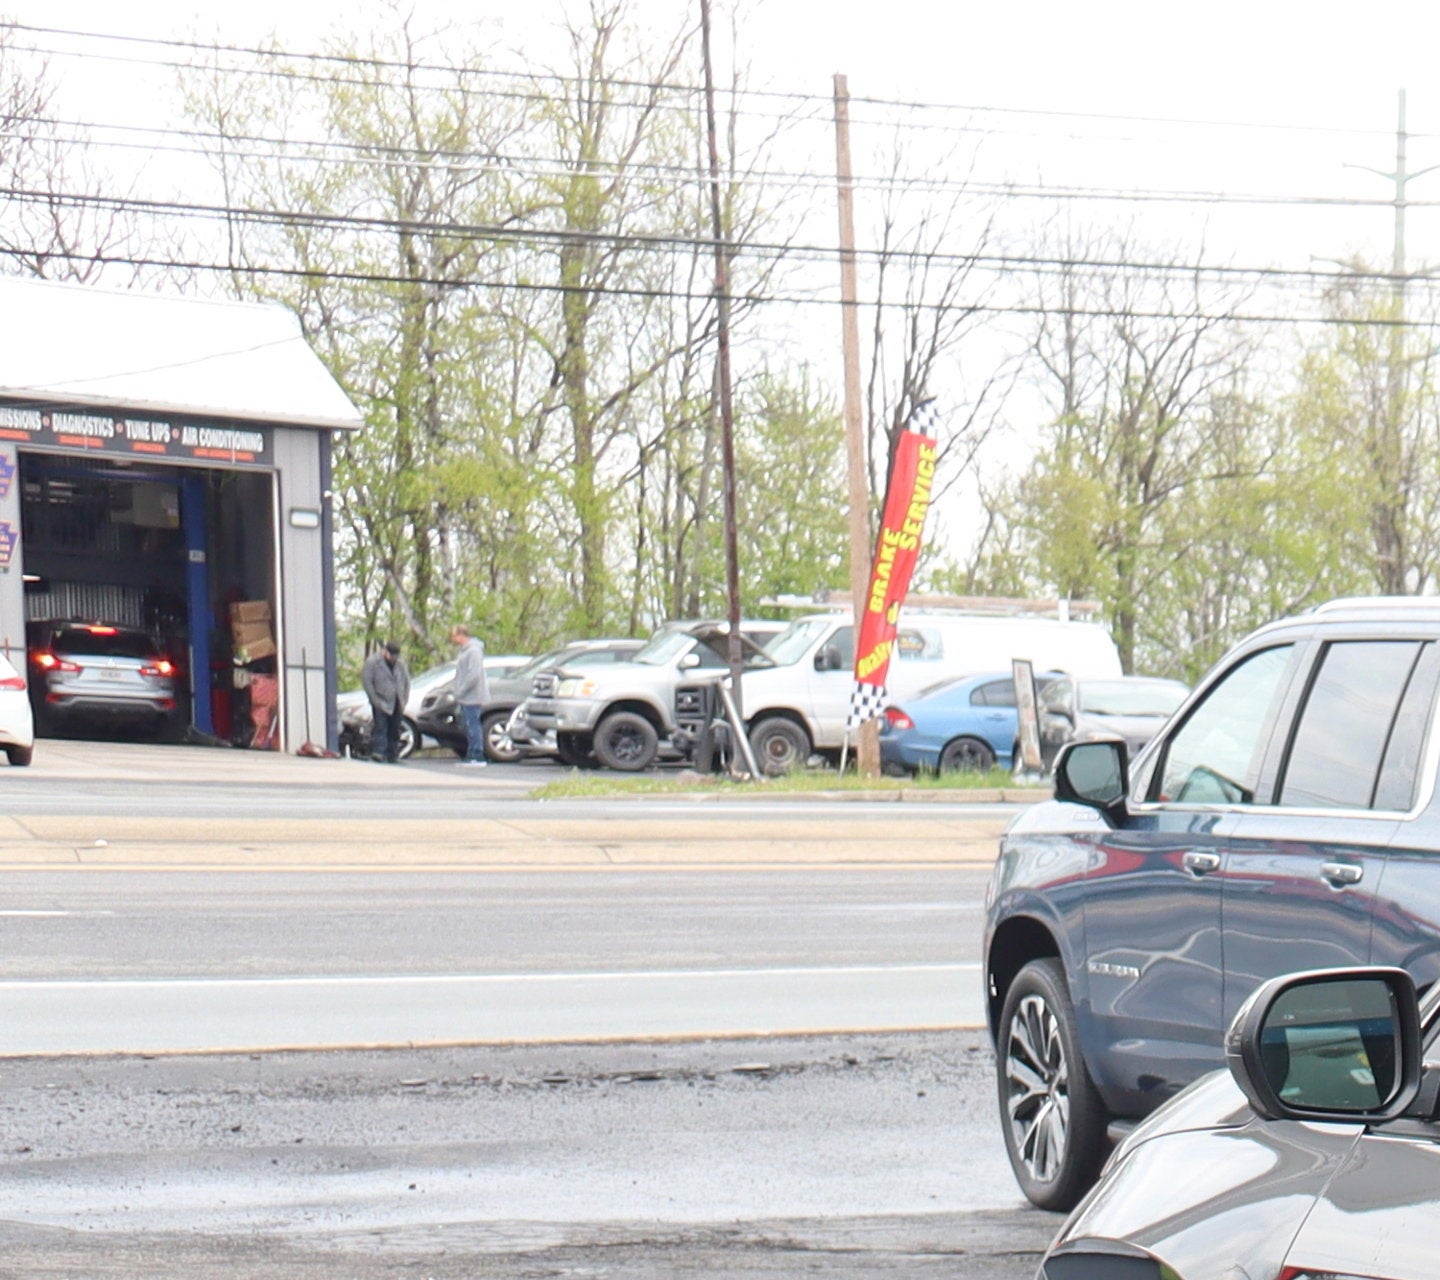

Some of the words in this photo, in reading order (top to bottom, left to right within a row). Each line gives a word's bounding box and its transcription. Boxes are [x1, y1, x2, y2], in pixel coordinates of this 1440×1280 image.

[52, 412, 114, 438] DIAGNOSTICS
[125, 419, 150, 441] TUNE
[151, 422, 171, 443] UPS
[182, 427, 199, 446] AIR
[199, 429, 263, 453] CONDITIONING
[900, 443, 937, 551] SERVICE
[868, 526, 901, 614] BRAKE
